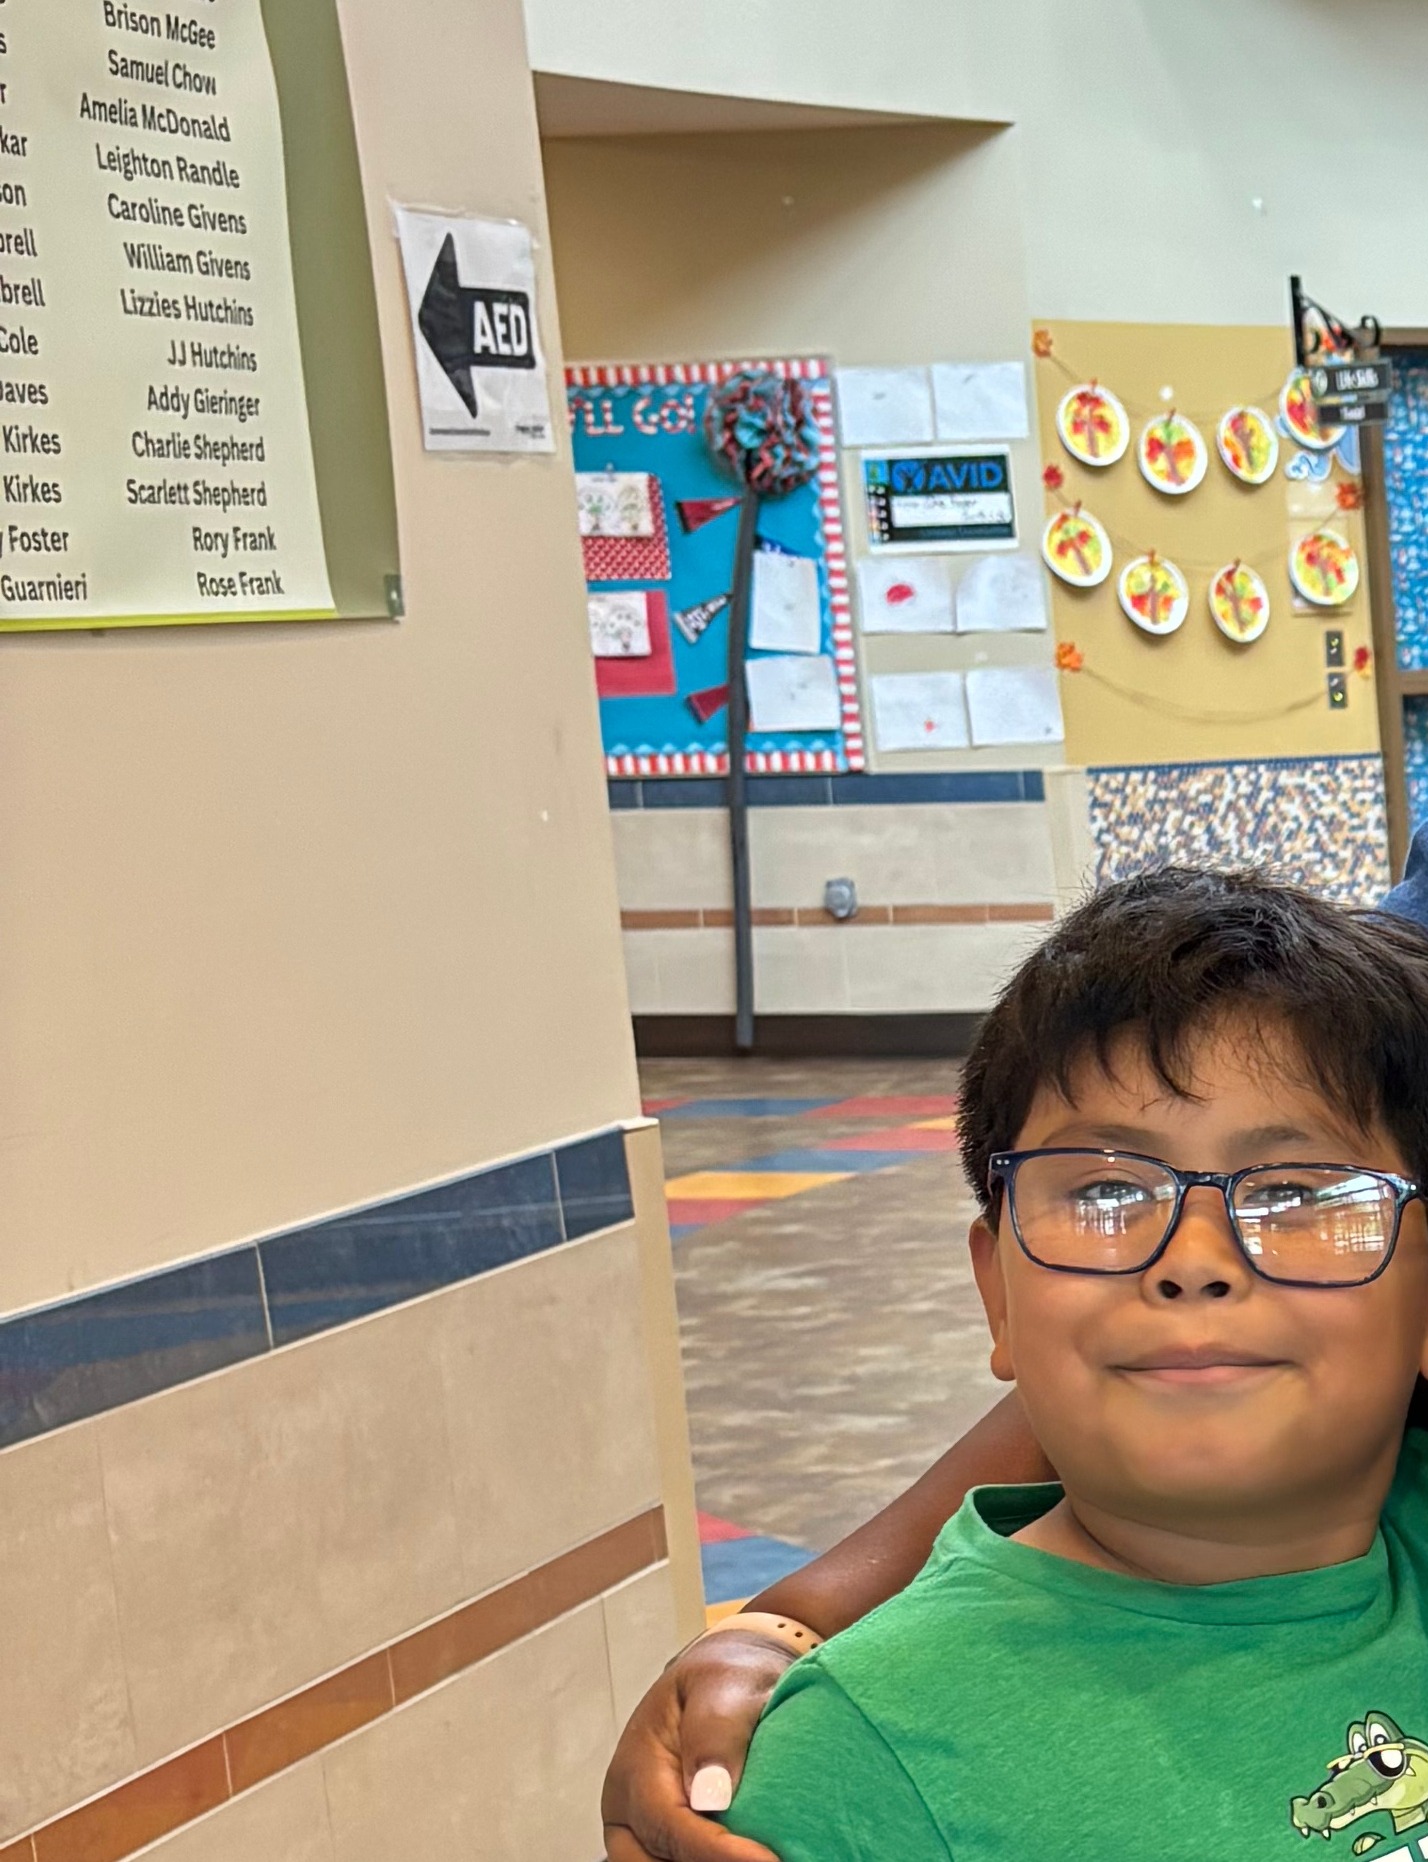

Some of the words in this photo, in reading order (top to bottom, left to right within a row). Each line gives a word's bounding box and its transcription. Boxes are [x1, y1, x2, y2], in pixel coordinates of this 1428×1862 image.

[103, 1, 161, 38] Brison
[166, 14, 215, 49] McGee
[108, 49, 169, 87] Samuel
[172, 63, 216, 96] Chow
[80, 92, 138, 128] Amelia
[142, 104, 231, 142] McDonald
[96, 143, 173, 181] Leighton
[177, 156, 240, 188] Randle
[107, 193, 184, 227] Caroline
[188, 204, 247, 234] Givens
[123, 242, 193, 274] William
[196, 250, 251, 280] Givens
[120, 288, 181, 320] Lizzies
[184, 295, 254, 326] Hutchins
[474, 301, 528, 356] AED
[167, 339, 186, 367] JJ
[191, 342, 257, 372] Hutchins
[148, 385, 189, 420] Addy
[194, 388, 260, 423] Gieringer
[632, 393, 696, 434] GO!
[2, 425, 61, 454] Kirkes
[132, 430, 190, 459] Charlie
[194, 434, 265, 467] Shepherd
[3, 475, 62, 503] Kirkes
[927, 460, 1003, 490] AVID
[126, 478, 190, 505] Scarlett
[193, 480, 267, 513] Shepherd
[8, 525, 69, 552] Foster
[192, 526, 228, 558] Rory
[233, 526, 277, 551] Frank
[0, 573, 87, 601] Guarnieri
[197, 571, 236, 597] Rose
[239, 570, 285, 596] Frank
